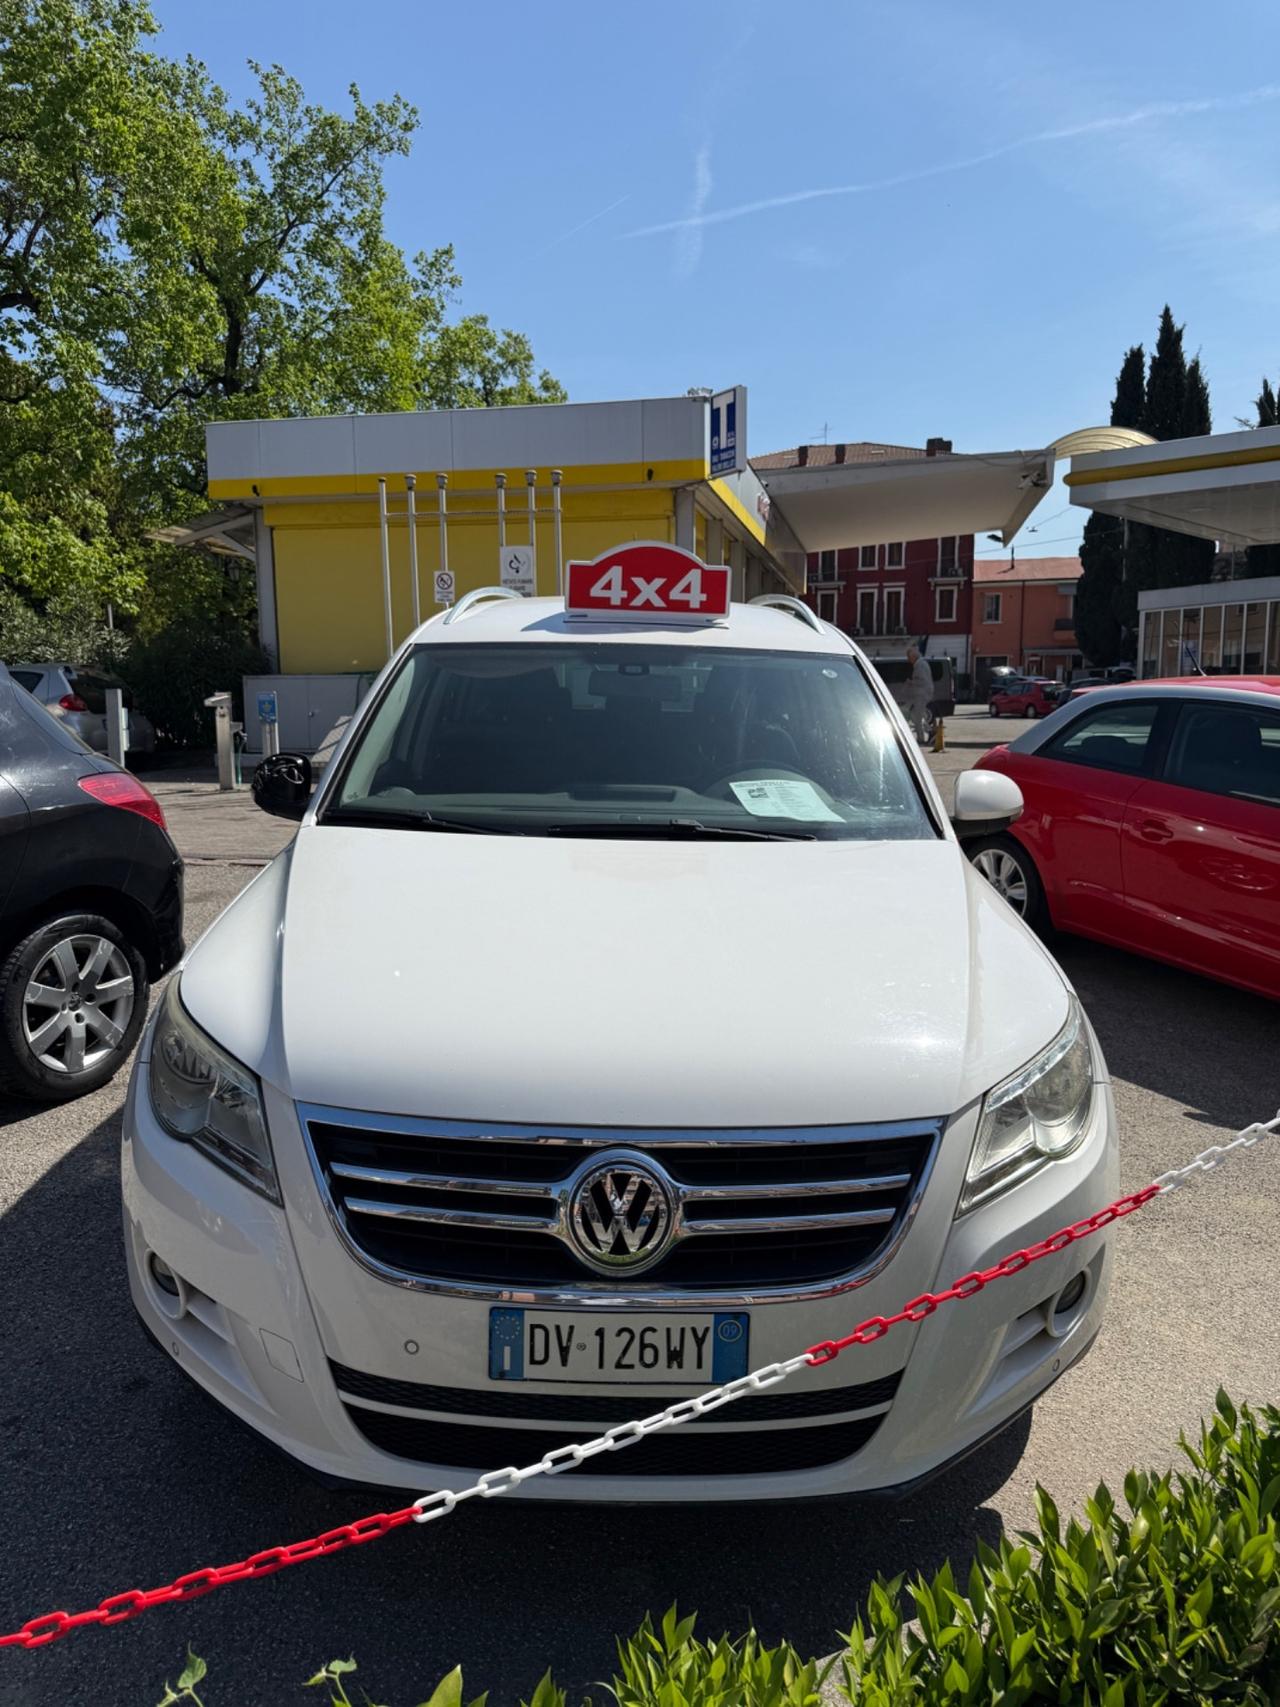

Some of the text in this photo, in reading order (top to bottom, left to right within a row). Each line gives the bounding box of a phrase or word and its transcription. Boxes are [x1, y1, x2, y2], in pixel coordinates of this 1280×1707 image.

[712, 390, 735, 449] T
[589, 565, 707, 609] 4x4
[573, 1165, 669, 1265] VW
[529, 1323, 710, 1370] DV 126WY
